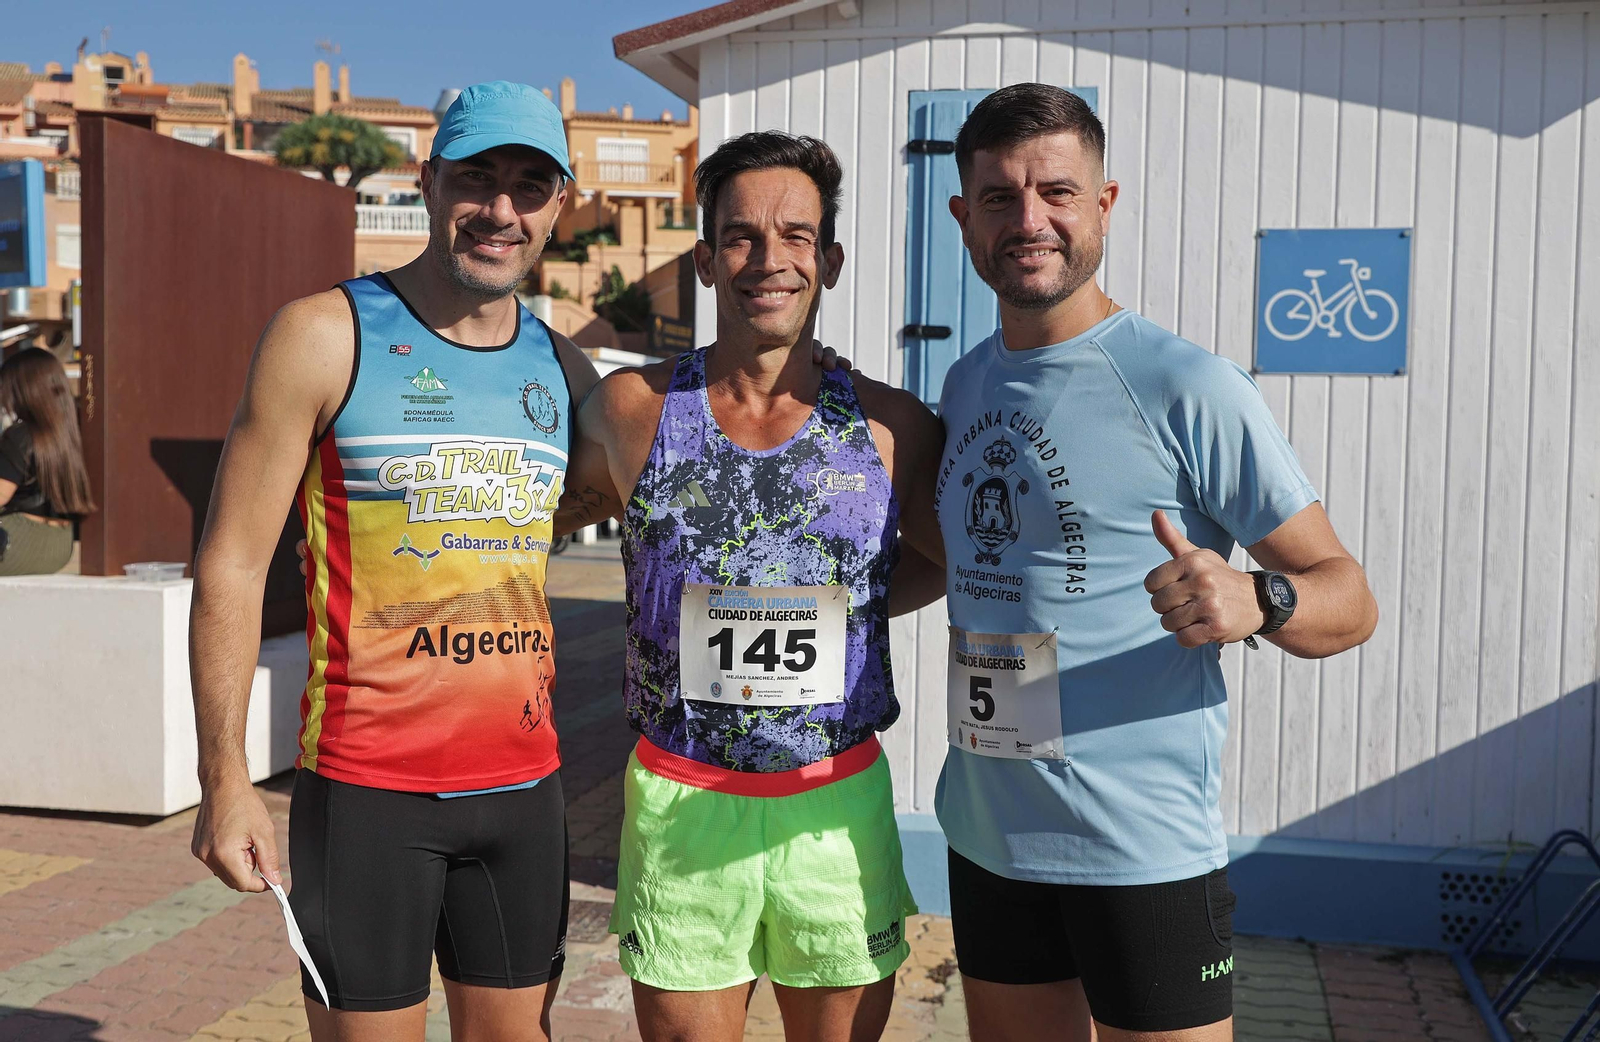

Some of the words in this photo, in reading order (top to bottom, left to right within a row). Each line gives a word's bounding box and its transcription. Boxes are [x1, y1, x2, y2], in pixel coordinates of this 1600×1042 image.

[416, 378, 438, 390] FAM
[956, 409, 1003, 455] URBANA
[1009, 411, 1058, 462] CIUDAD
[386, 461, 436, 484] C.D.
[437, 448, 522, 480] TRAIL
[833, 473, 854, 481] BMW
[1046, 465, 1070, 491] DE
[413, 485, 505, 514] TEAM
[441, 532, 509, 551] Gabarras
[511, 534, 521, 550] &
[1054, 500, 1087, 594] ALGECIRAS
[955, 565, 1023, 587] Ayuntamiento
[708, 596, 764, 609] CARRERA
[766, 597, 818, 609] URBANA
[709, 588, 722, 596] XXIV
[724, 589, 749, 597] EDICIÓN
[955, 581, 962, 593] de
[963, 580, 1021, 603] Algeciras
[708, 608, 747, 620] CIUDAD
[750, 610, 763, 621] DE
[764, 610, 818, 621] ALGECIRAS
[406, 622, 550, 665] Algeciras
[708, 627, 817, 673] 145
[979, 643, 1025, 657] URBANA
[968, 656, 977, 668] DE
[979, 657, 1026, 670] ALGECIRAS
[969, 675, 995, 721] 5
[867, 928, 890, 945] BMW
[867, 938, 892, 952] BERLIN
